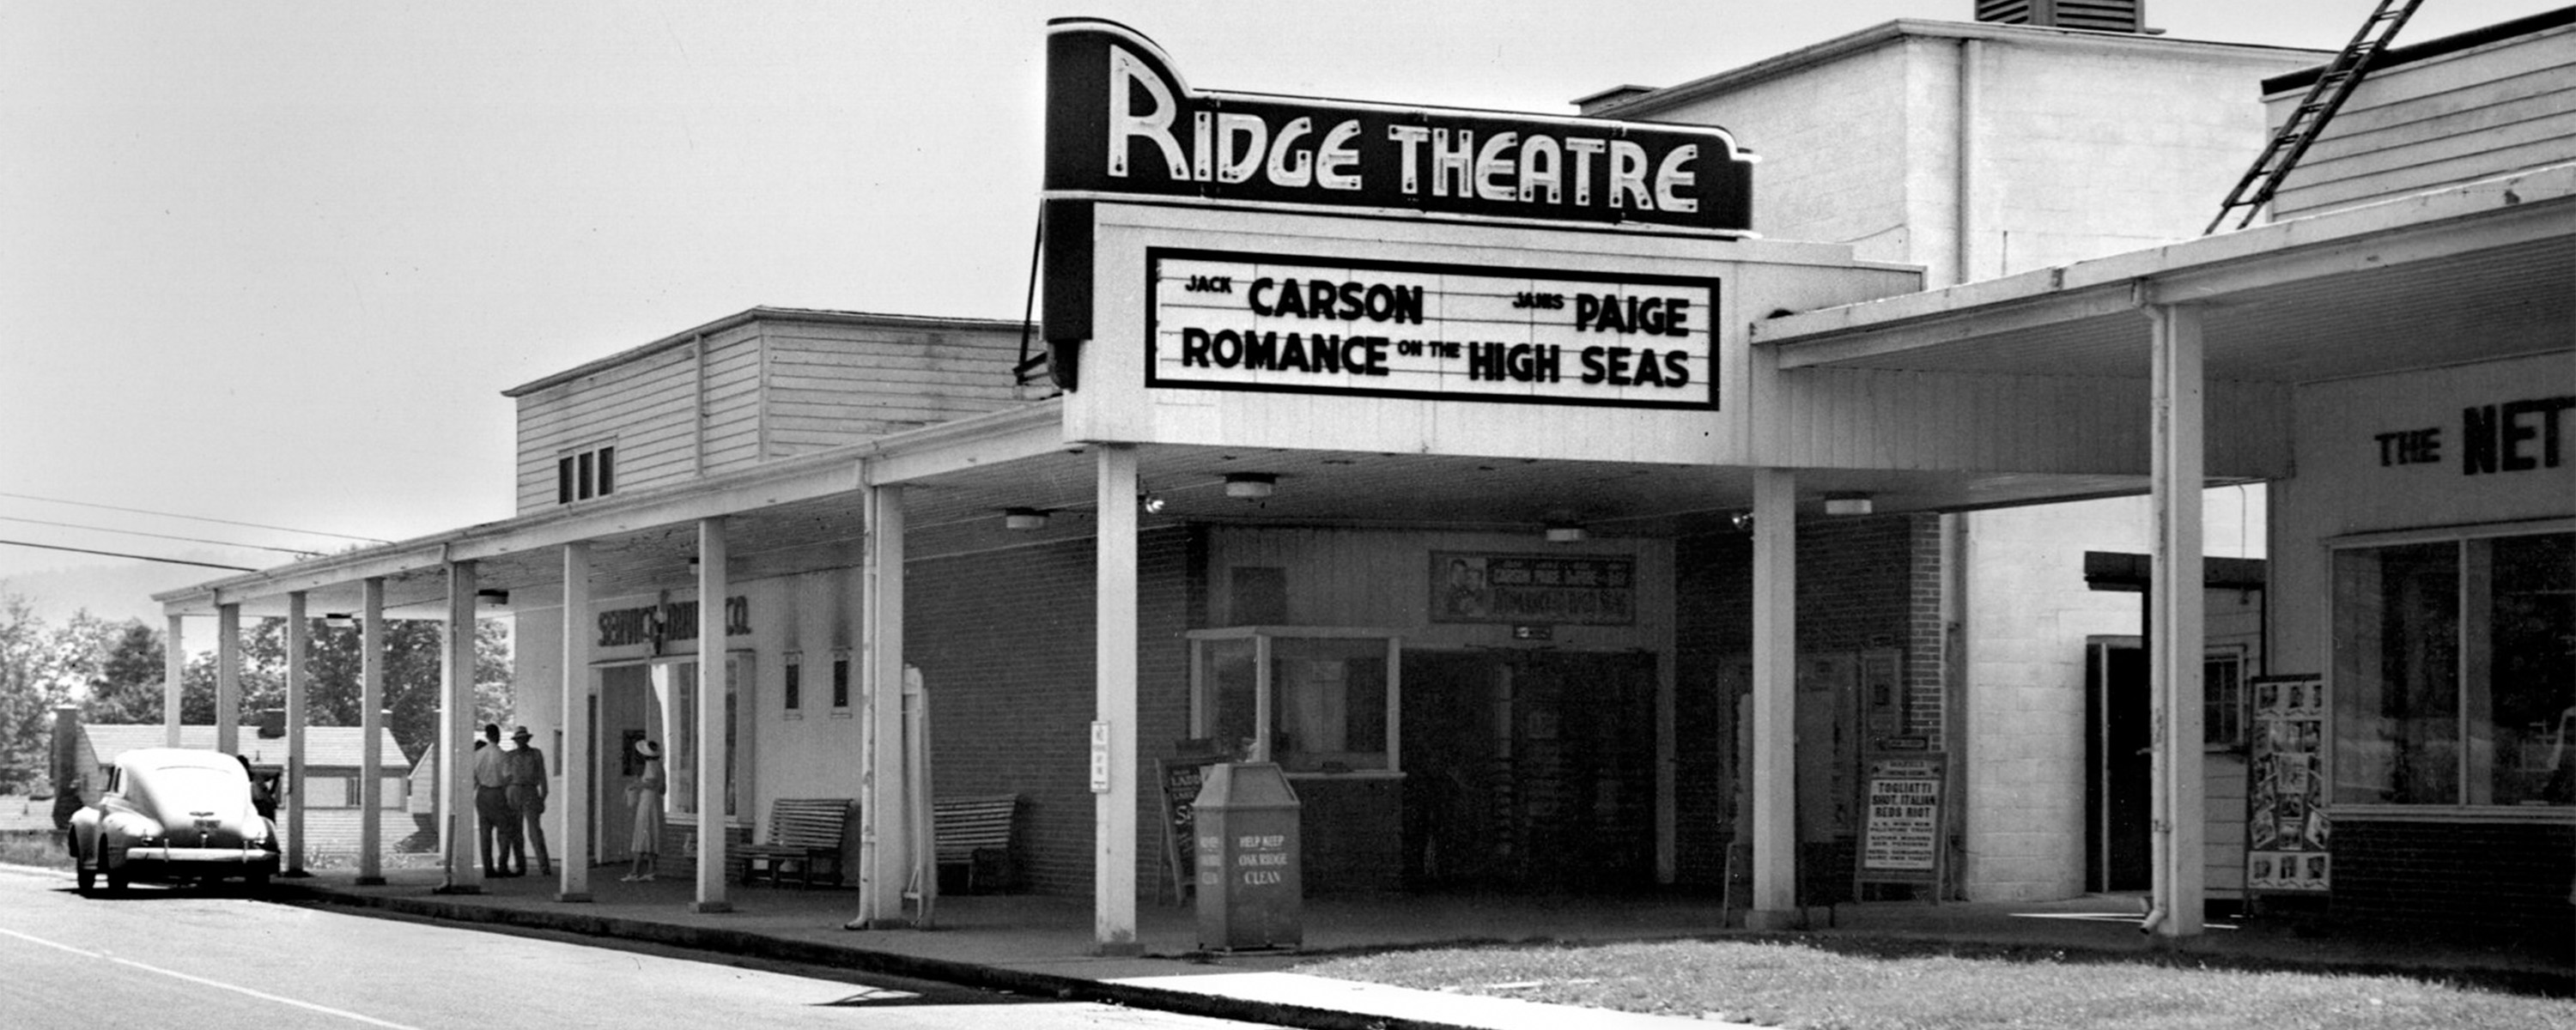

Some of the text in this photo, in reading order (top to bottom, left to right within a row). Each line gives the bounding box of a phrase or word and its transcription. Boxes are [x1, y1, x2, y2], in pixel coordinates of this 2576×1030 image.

[1108, 44, 1698, 213] RIDGE THEATRE
[1185, 275, 1690, 336] JACK CARSON JANIS PAIGE
[1182, 327, 1690, 388] ROMANCE ON THE HIGH SEAS
[2373, 427, 2441, 467] THE
[1878, 782, 1931, 793] TOGLIATTI
[1874, 807, 1930, 818] REDS RIOT
[1239, 834, 1285, 848] HELP KEEP
[1238, 852, 1288, 866] OAK RIDGE
[1243, 870, 1281, 885] CLEAN
